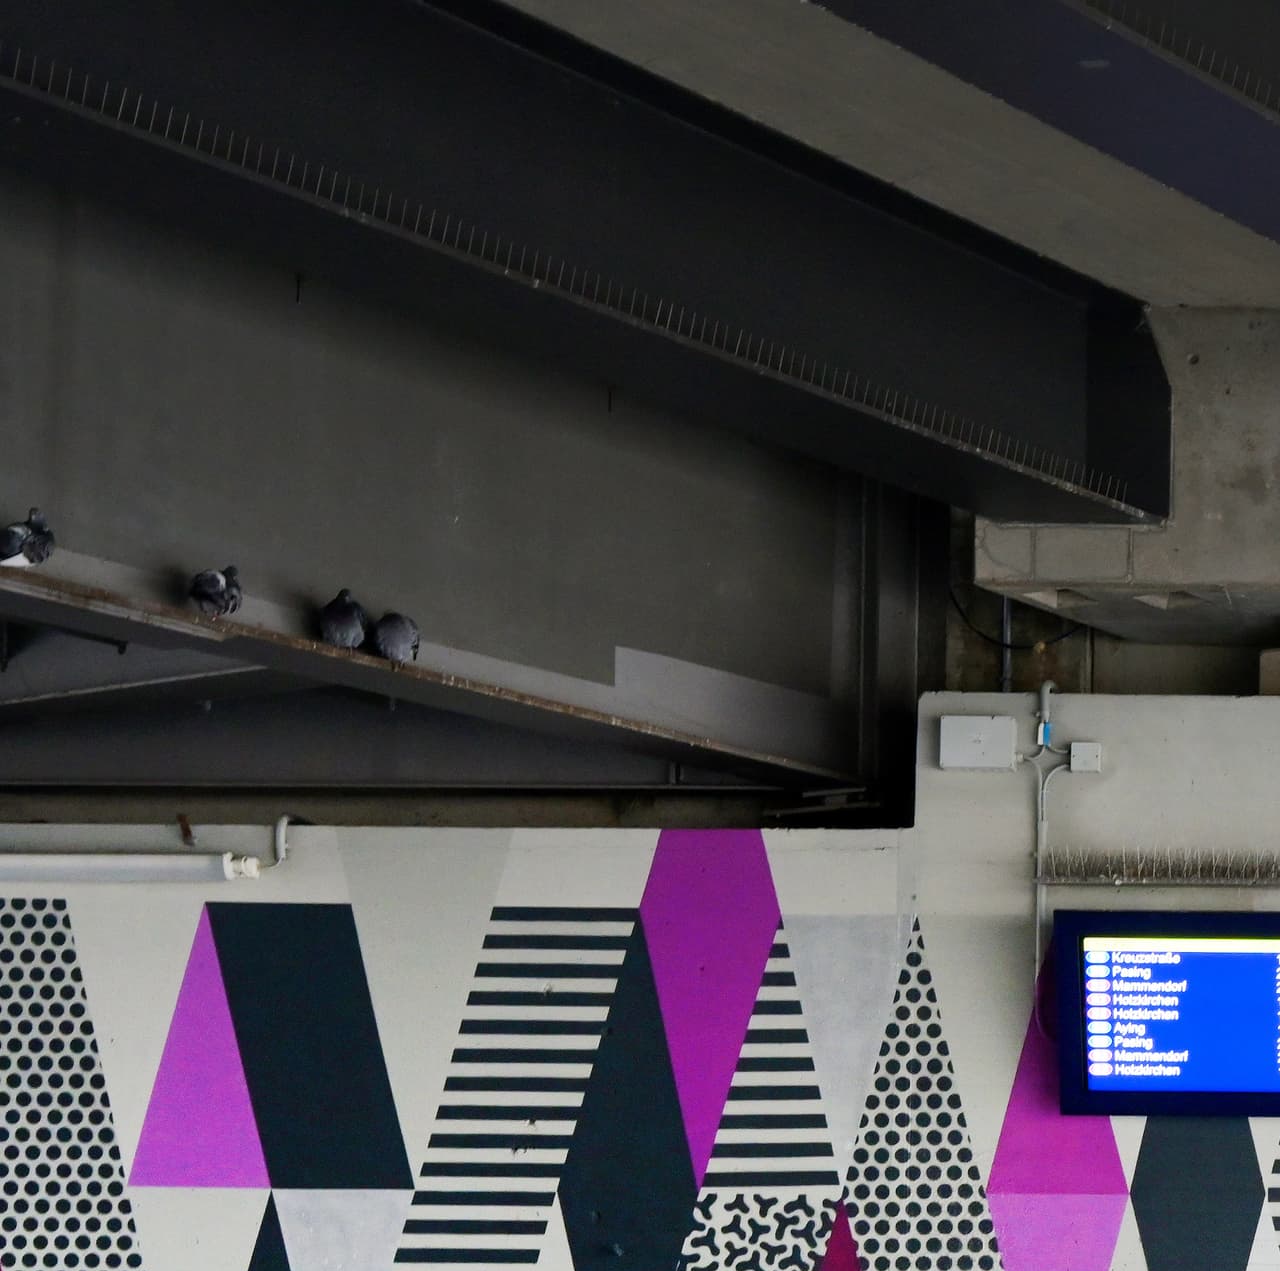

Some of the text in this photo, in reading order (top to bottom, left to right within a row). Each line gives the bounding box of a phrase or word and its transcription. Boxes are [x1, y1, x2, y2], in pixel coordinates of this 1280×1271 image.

[1111, 951, 1181, 964] Kreuzstraße
[1111, 966, 1151, 980] Pasing
[1112, 980, 1187, 993] Mammendorf
[1113, 994, 1179, 1007] Holzkirchen
[1113, 1008, 1179, 1021] Holzkirchen
[1114, 1022, 1146, 1036] Aying
[1114, 1036, 1153, 1050] Pasing
[1115, 1049, 1189, 1063] Mammendorf
[1115, 1063, 1181, 1077] Holzkirchen
